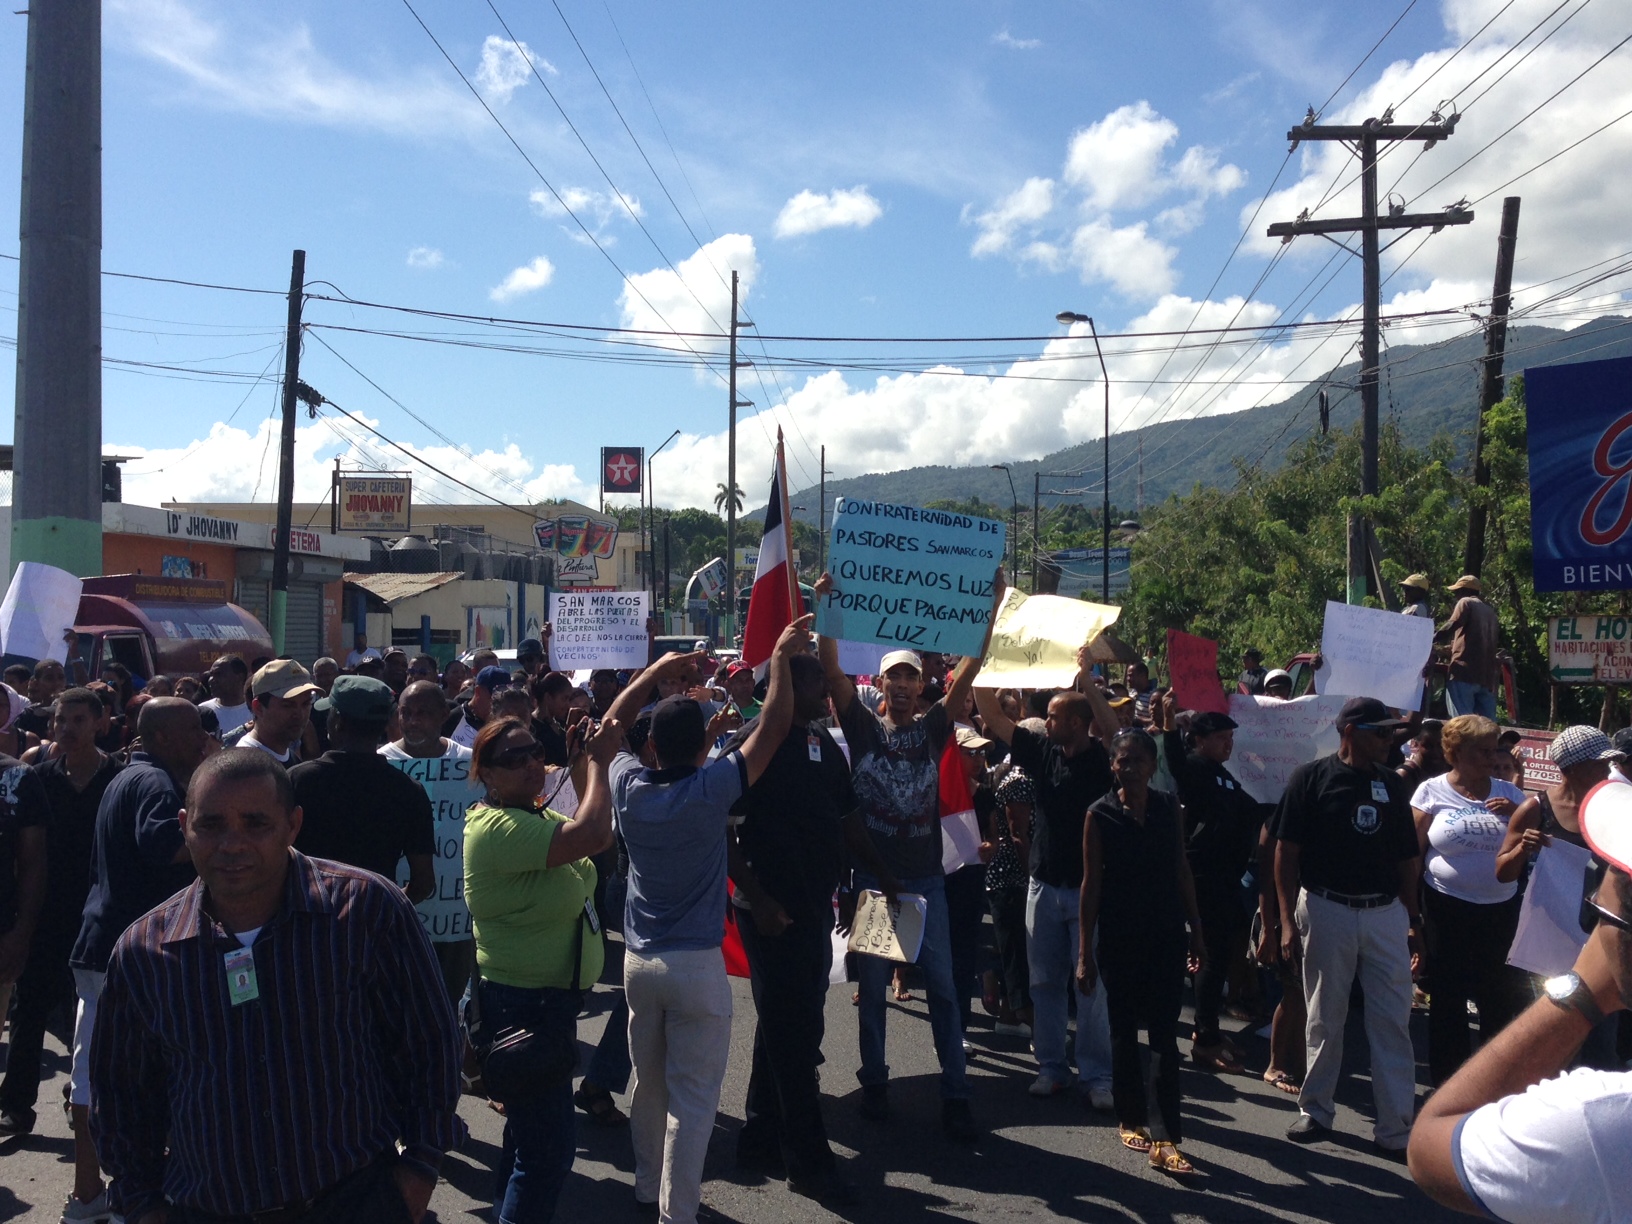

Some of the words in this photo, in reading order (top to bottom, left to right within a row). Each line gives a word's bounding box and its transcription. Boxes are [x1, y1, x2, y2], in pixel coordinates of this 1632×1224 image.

[346, 481, 366, 492] SUPER
[370, 482, 405, 493] CAFETERIA
[346, 495, 404, 512] JHOVANNY
[836, 498, 972, 528] CONFRATERNIDAD
[979, 520, 998, 534] DE
[186, 516, 238, 540] JHOVANNY
[836, 529, 919, 552] PASTORES
[564, 558, 594, 573] Pintura
[744, 554, 758, 564] Torr
[136, 584, 179, 596] DISTRIBUIDORA
[180, 586, 188, 597] DE
[190, 587, 224, 598] COMBUSTIBLE
[958, 575, 994, 598] LUZ
[558, 596, 584, 608] SAN
[591, 596, 640, 606] MARCOS
[828, 590, 912, 615] PORQUE
[915, 599, 990, 624] PAGAMOS
[558, 608, 585, 617] ABRE
[1556, 618, 1582, 640] EL
[1555, 641, 1625, 654] HABITACIONES
[1529, 762, 1561, 772] ORTEGA
[1445, 805, 1489, 826] AEROPO
[871, 912, 888, 948] Base
